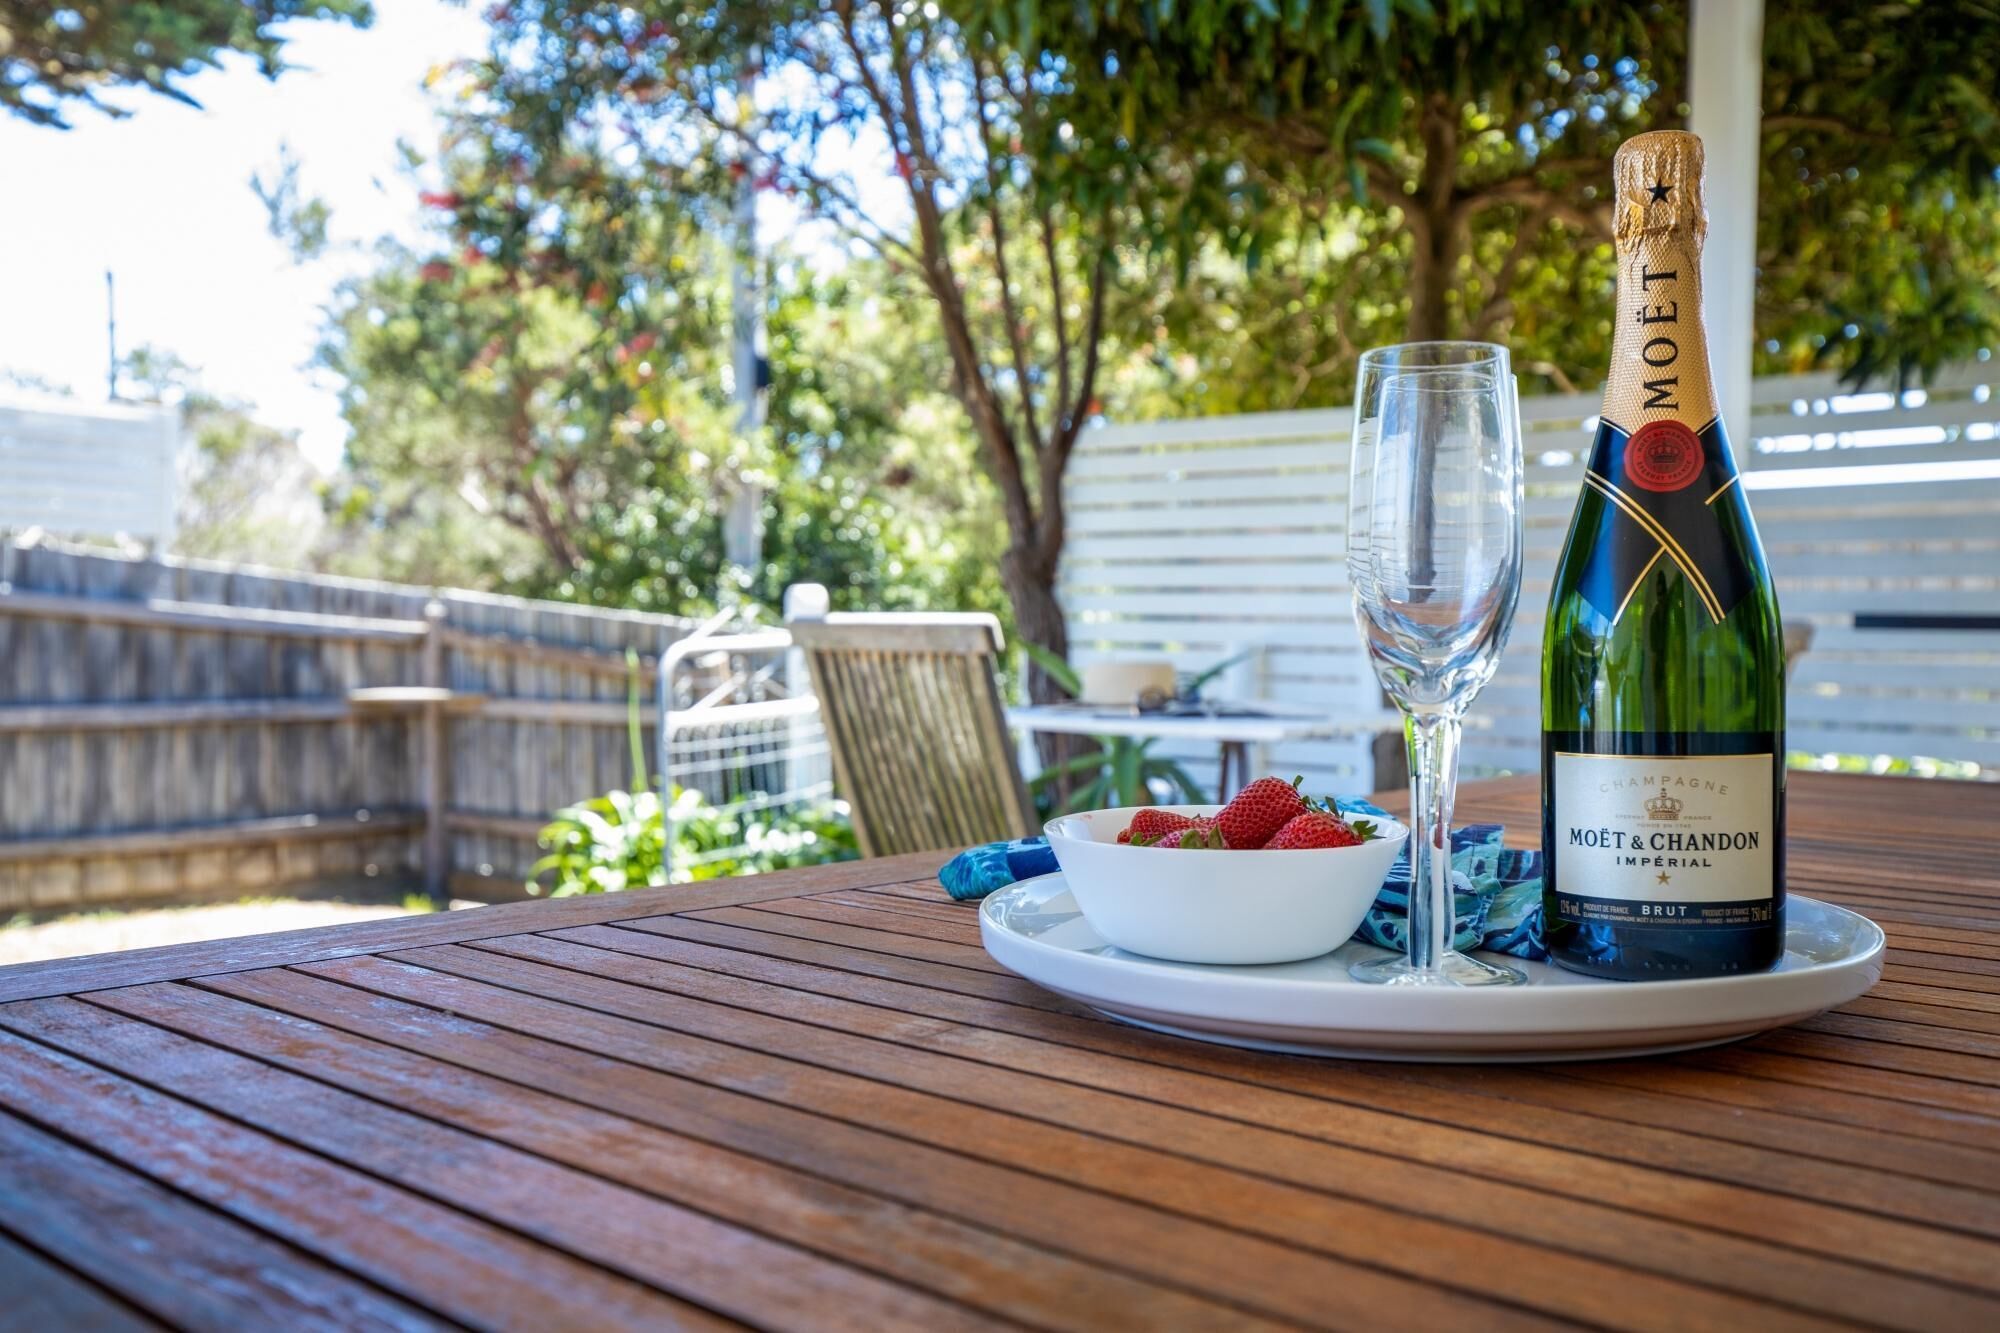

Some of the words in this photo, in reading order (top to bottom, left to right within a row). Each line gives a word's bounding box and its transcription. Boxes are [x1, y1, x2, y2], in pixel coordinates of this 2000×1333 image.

[1637, 264, 1679, 411] MOËT
[1599, 775, 1729, 796] CHAMPAGNE
[1569, 827, 1626, 849] MOËT
[1631, 835, 1644, 850] &
[1650, 831, 1760, 851] CHANDON
[1616, 855, 1712, 868] IMPÉRIAL
[1641, 905, 1688, 917] BRUT
